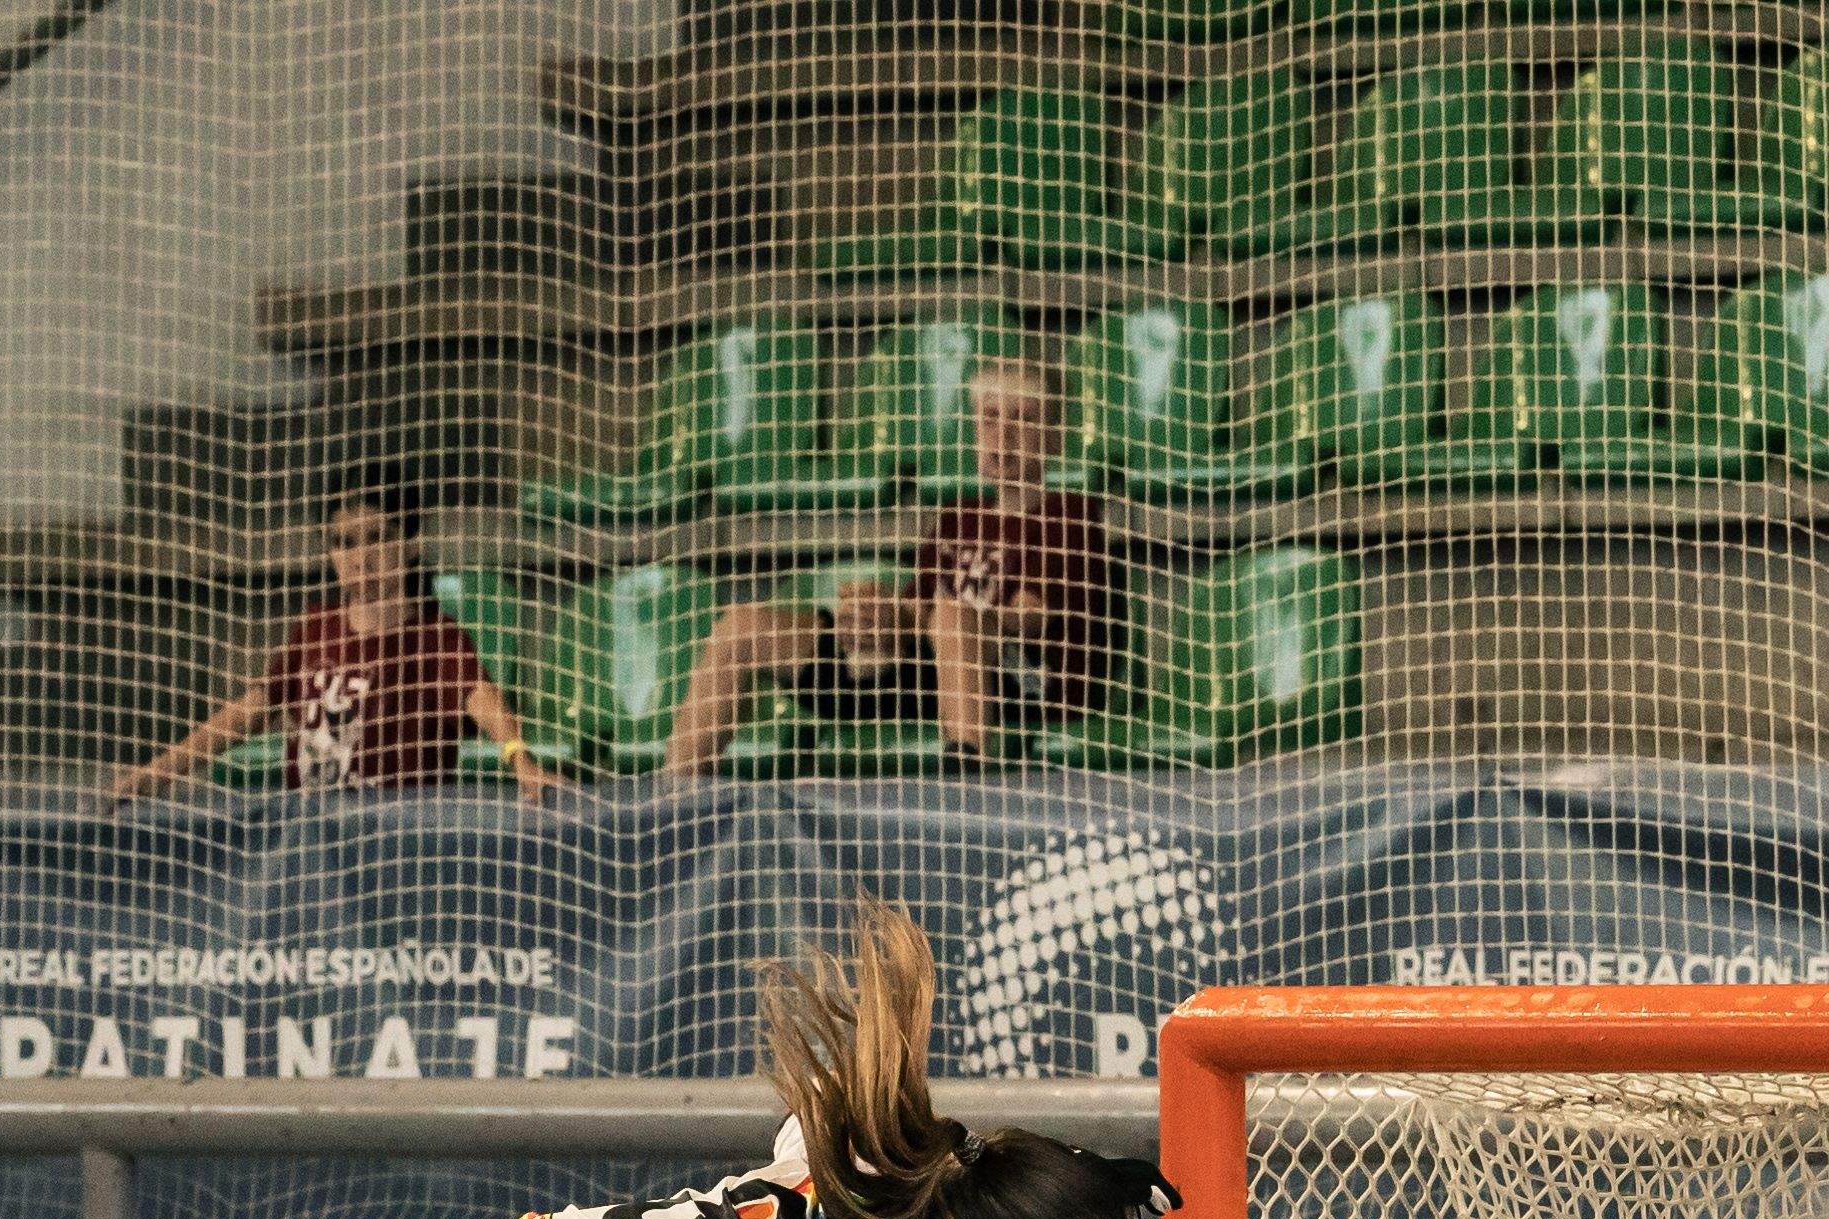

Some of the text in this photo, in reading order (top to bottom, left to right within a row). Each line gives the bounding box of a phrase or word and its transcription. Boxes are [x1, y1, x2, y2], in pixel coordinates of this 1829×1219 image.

[91, 938, 301, 987] FEDERACIÓN
[305, 937, 499, 987] ESPAÑOLA
[503, 947, 555, 987] DE
[1394, 949, 1497, 985] REAL
[1509, 944, 1792, 985] FEDERACIÓN
